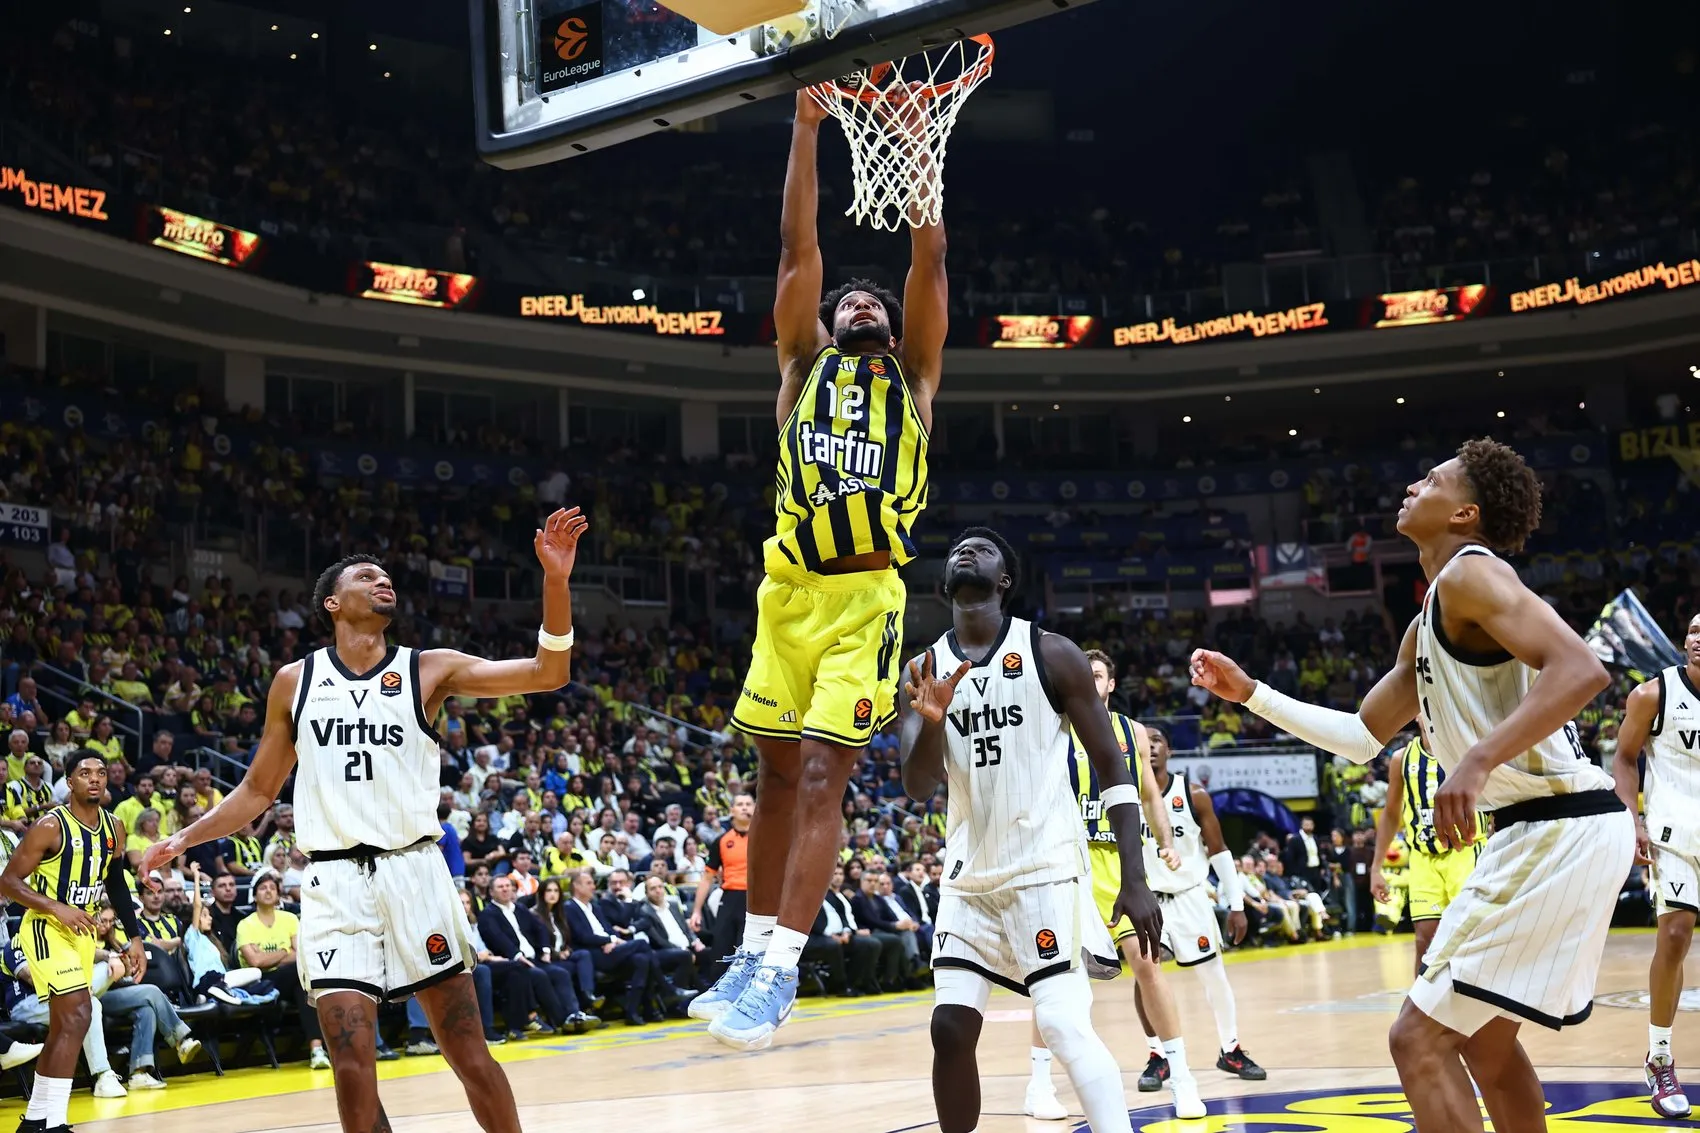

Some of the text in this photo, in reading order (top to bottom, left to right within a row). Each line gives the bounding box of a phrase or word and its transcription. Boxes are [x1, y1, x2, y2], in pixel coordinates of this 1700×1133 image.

[543, 59, 601, 83] EuroLeague
[23, 180, 109, 220] DEMEZ
[163, 221, 225, 246] metro
[373, 273, 438, 291] metro
[655, 311, 725, 335] DEMEZ
[1251, 302, 1329, 337] DEMEZ
[826, 381, 865, 421] 12
[801, 424, 881, 477] tarfin
[12, 507, 40, 524] 203
[12, 525, 40, 543] 103
[752, 692, 778, 708] Hotels
[310, 718, 404, 747] Virtus
[947, 703, 1024, 737] Vrtus
[974, 735, 1002, 768] 35
[345, 750, 373, 782] 21
[89, 856, 103, 877] 11
